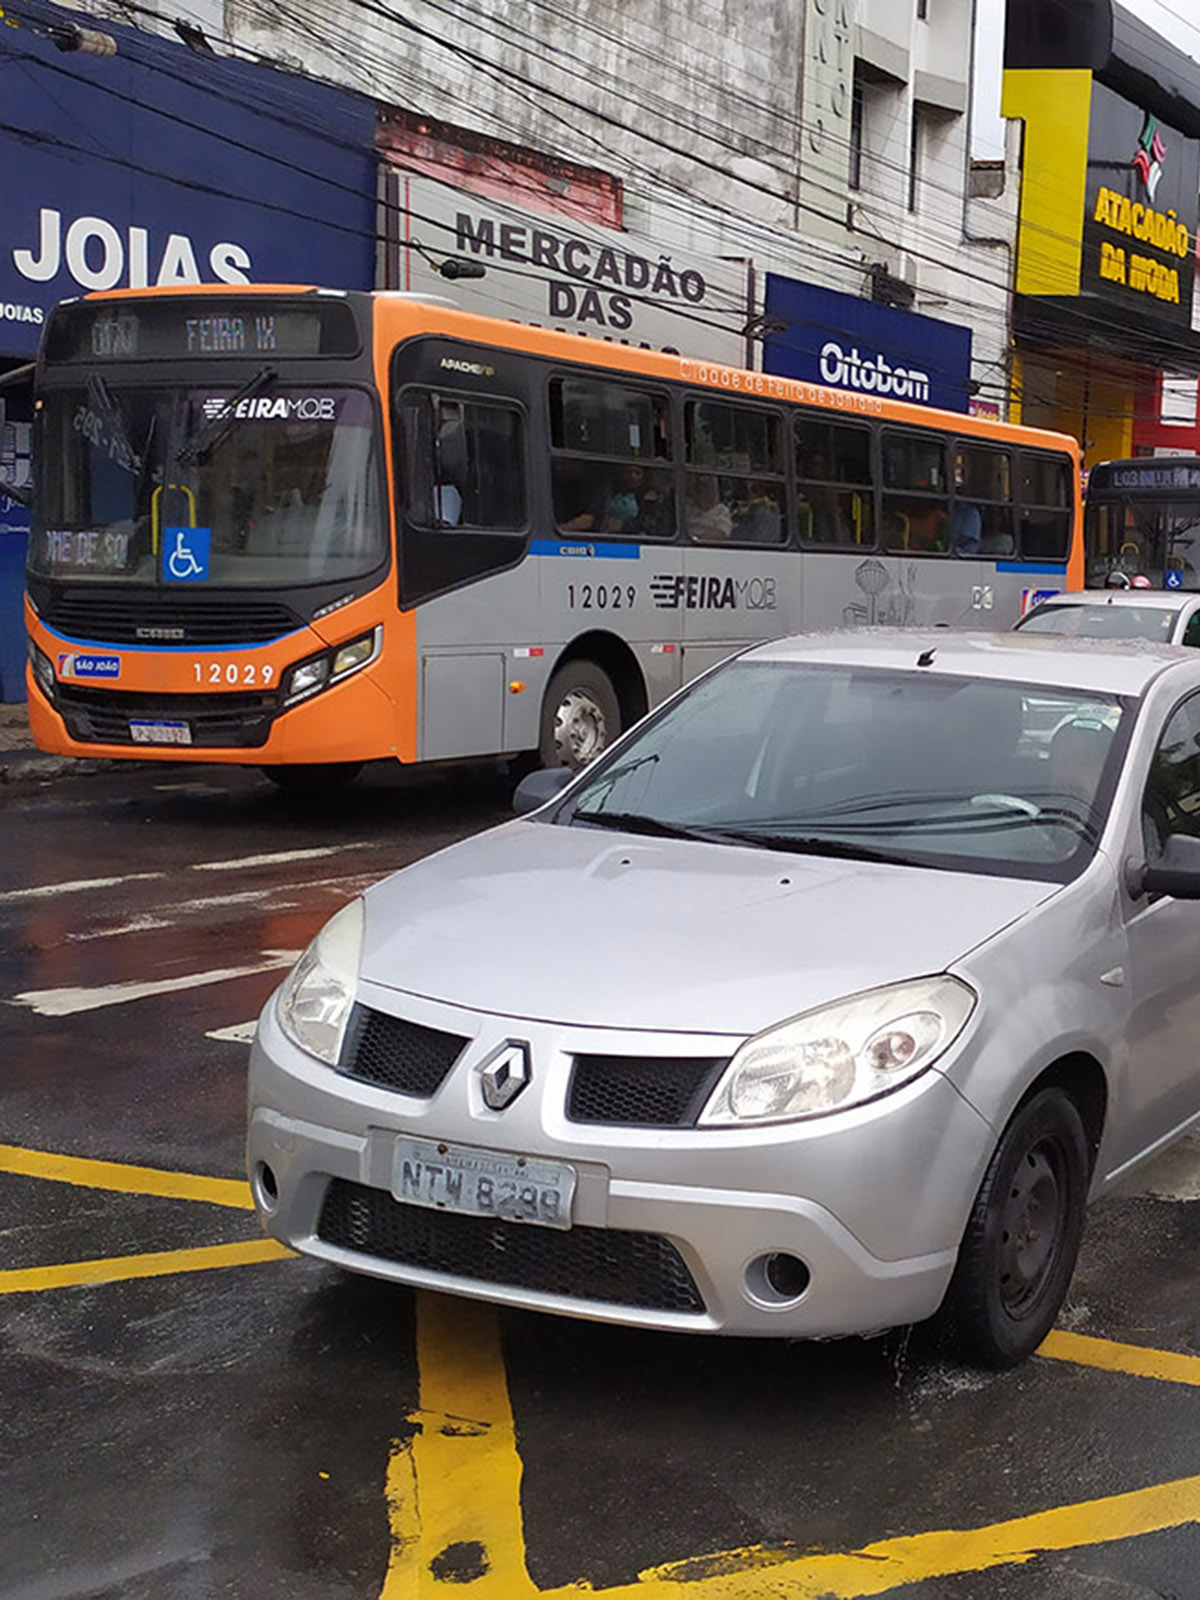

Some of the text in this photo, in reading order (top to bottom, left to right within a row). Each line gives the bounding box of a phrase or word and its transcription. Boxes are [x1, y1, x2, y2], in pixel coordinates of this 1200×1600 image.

[1094, 186, 1188, 258] ATACADÃO
[13, 208, 251, 291] JOIAS
[456, 212, 705, 303] MERCADÃO
[1100, 241, 1126, 285] DA
[1129, 253, 1180, 305] MODA
[549, 281, 634, 330] DAS
[186, 318, 245, 351] FEIRA
[819, 342, 930, 401] Ortobom
[567, 585, 637, 609] 12029
[193, 664, 274, 684] 12029
